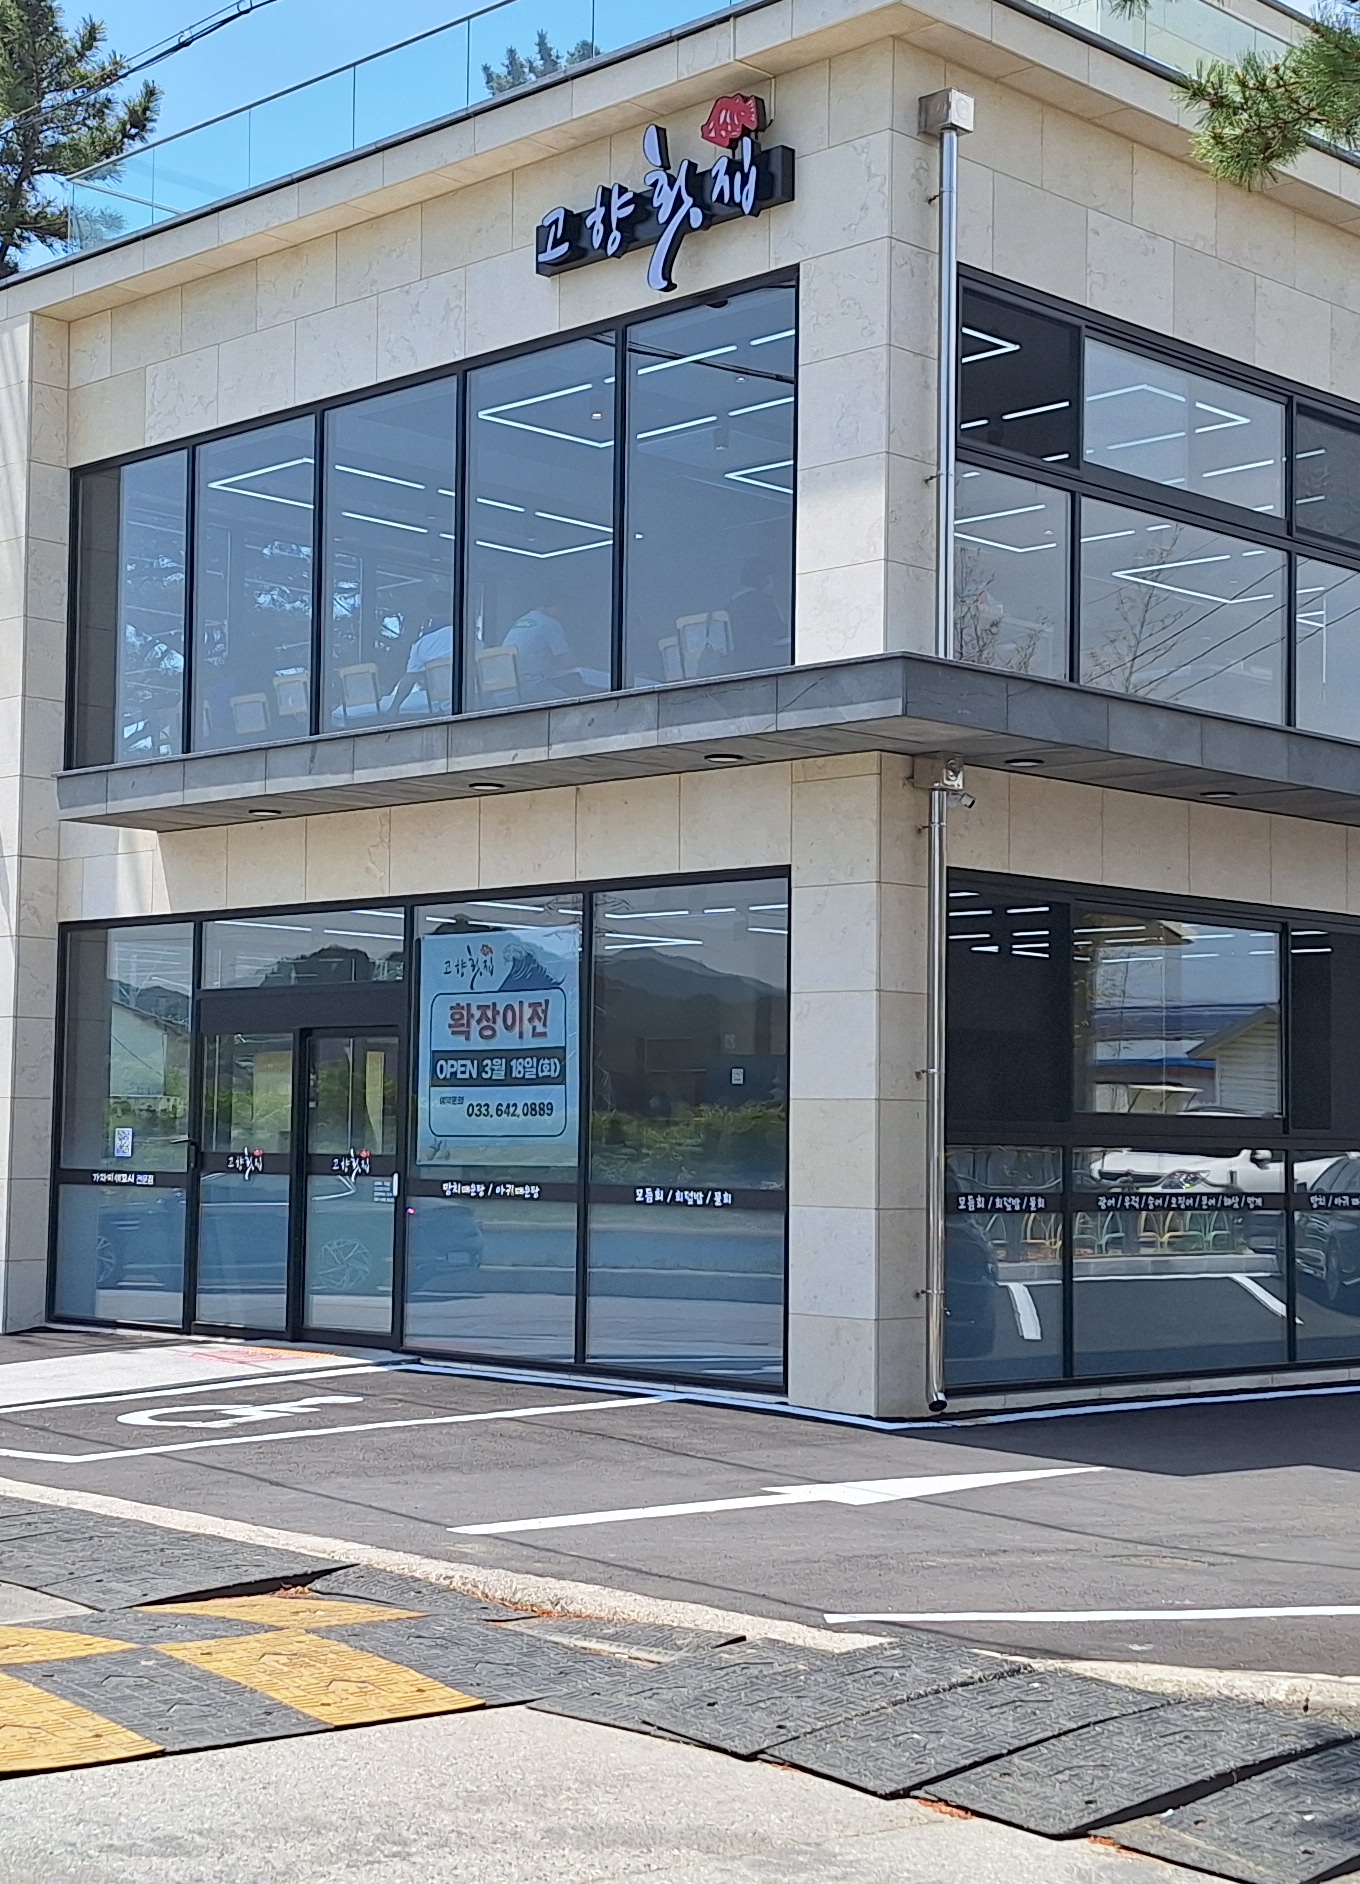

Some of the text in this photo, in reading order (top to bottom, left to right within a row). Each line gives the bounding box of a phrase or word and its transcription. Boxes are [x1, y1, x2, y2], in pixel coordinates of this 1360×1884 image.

[537, 124, 757, 290] 고향횟집
[443, 944, 495, 990] 고향횟집
[447, 999, 550, 1041] 확장이전
[436, 1056, 561, 1080] OPEN 3월 18일(화)
[466, 1102, 554, 1118] 033.642.0889
